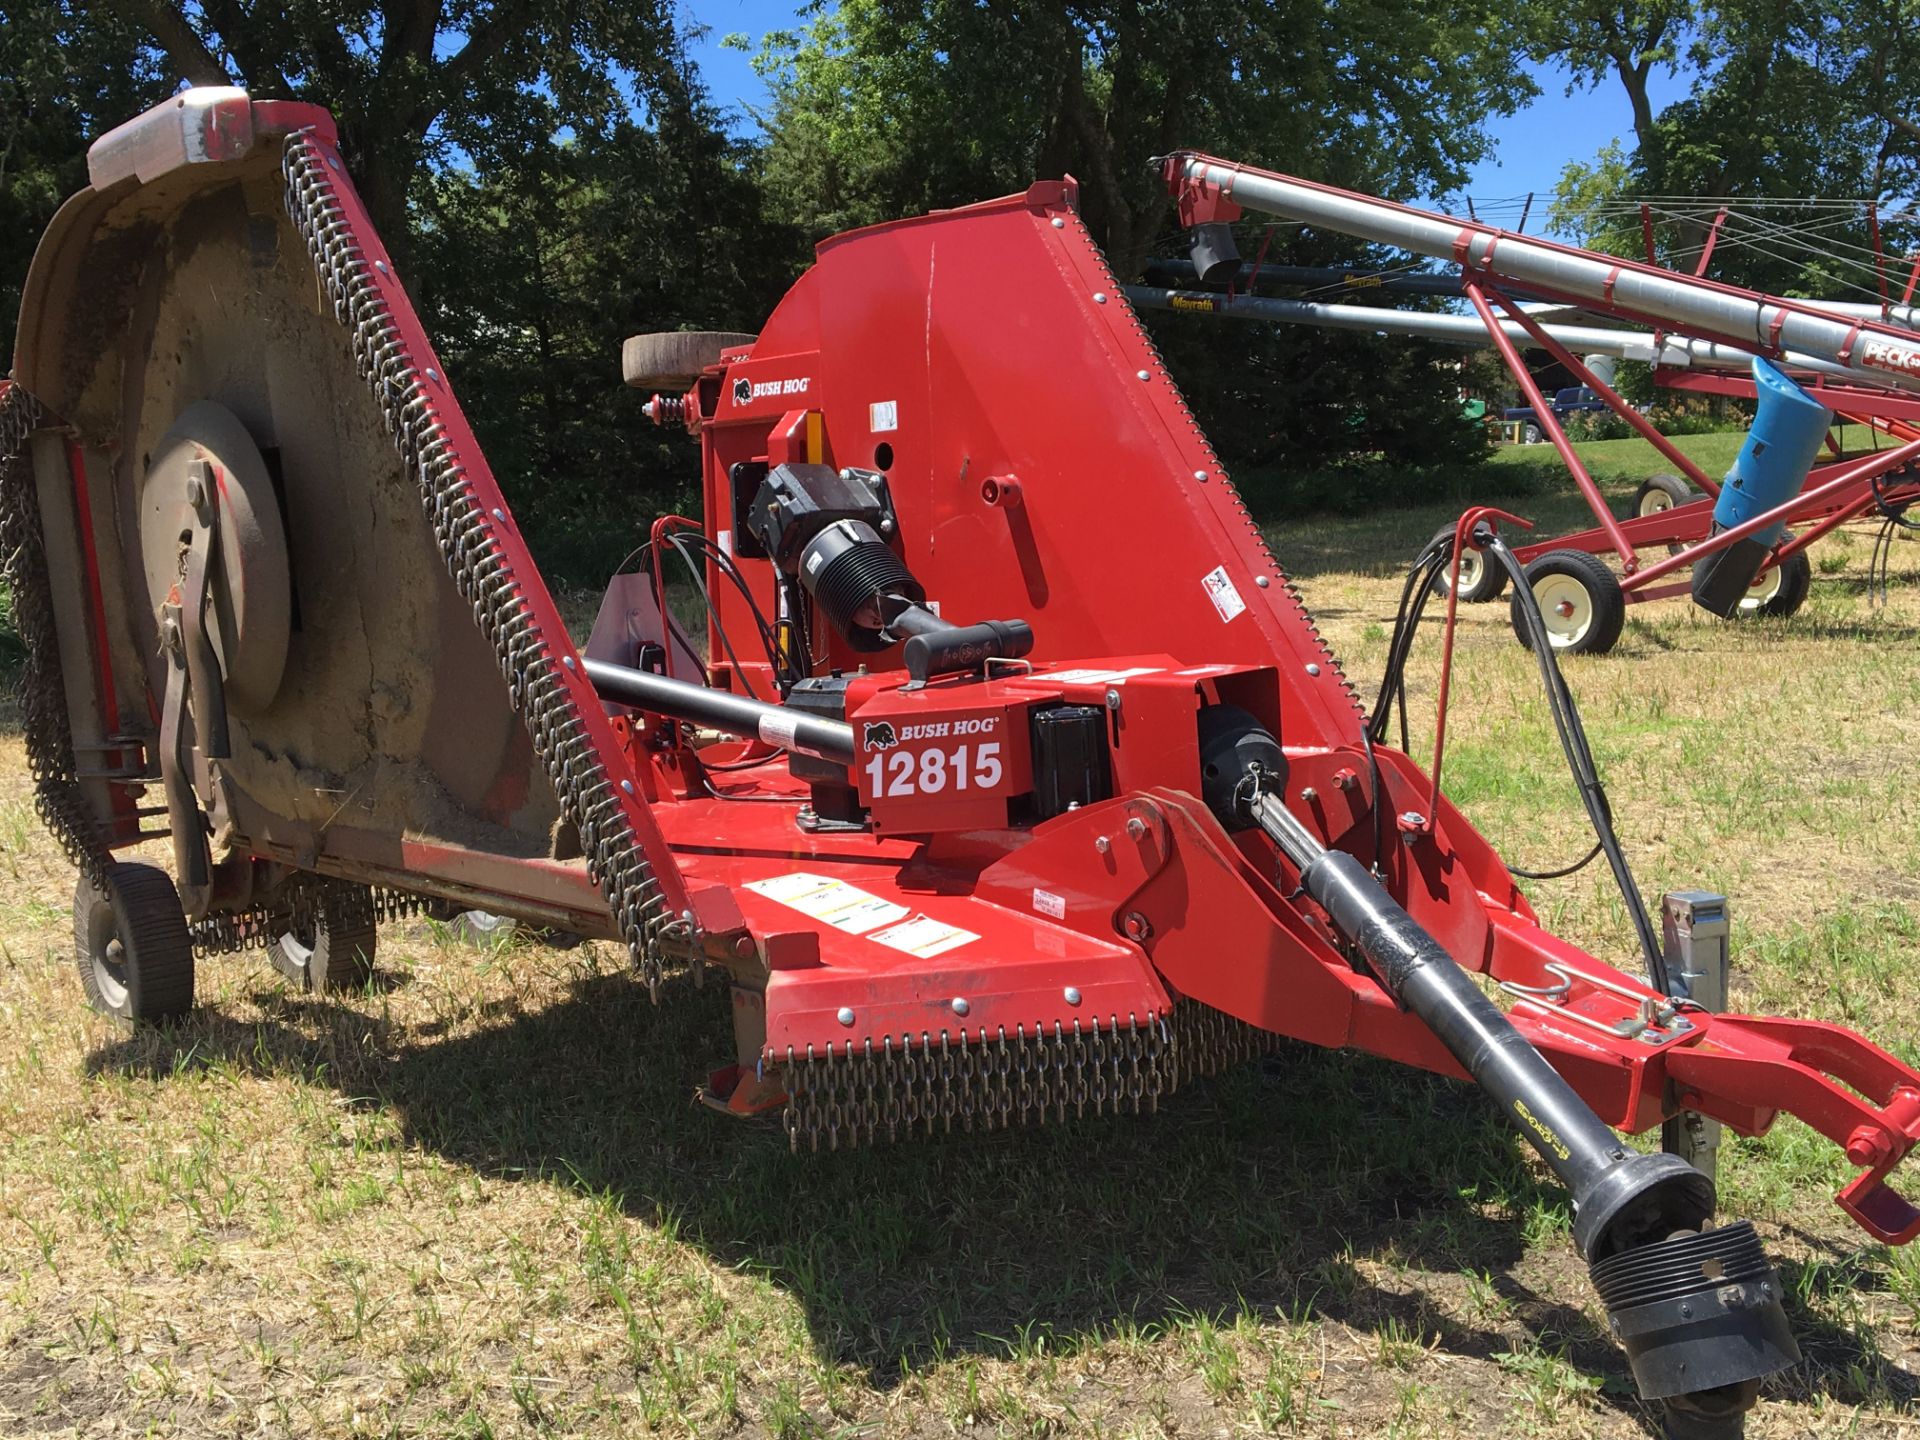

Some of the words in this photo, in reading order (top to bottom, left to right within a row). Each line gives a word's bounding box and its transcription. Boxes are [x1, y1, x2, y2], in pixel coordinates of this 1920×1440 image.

[1172, 296, 1213, 312] Mayrath
[1865, 342, 1914, 369] PECK
[753, 381, 781, 397] BUSH
[783, 378, 808, 394] HOG
[900, 722, 950, 741] BUSH
[866, 742, 1002, 798] 12815
